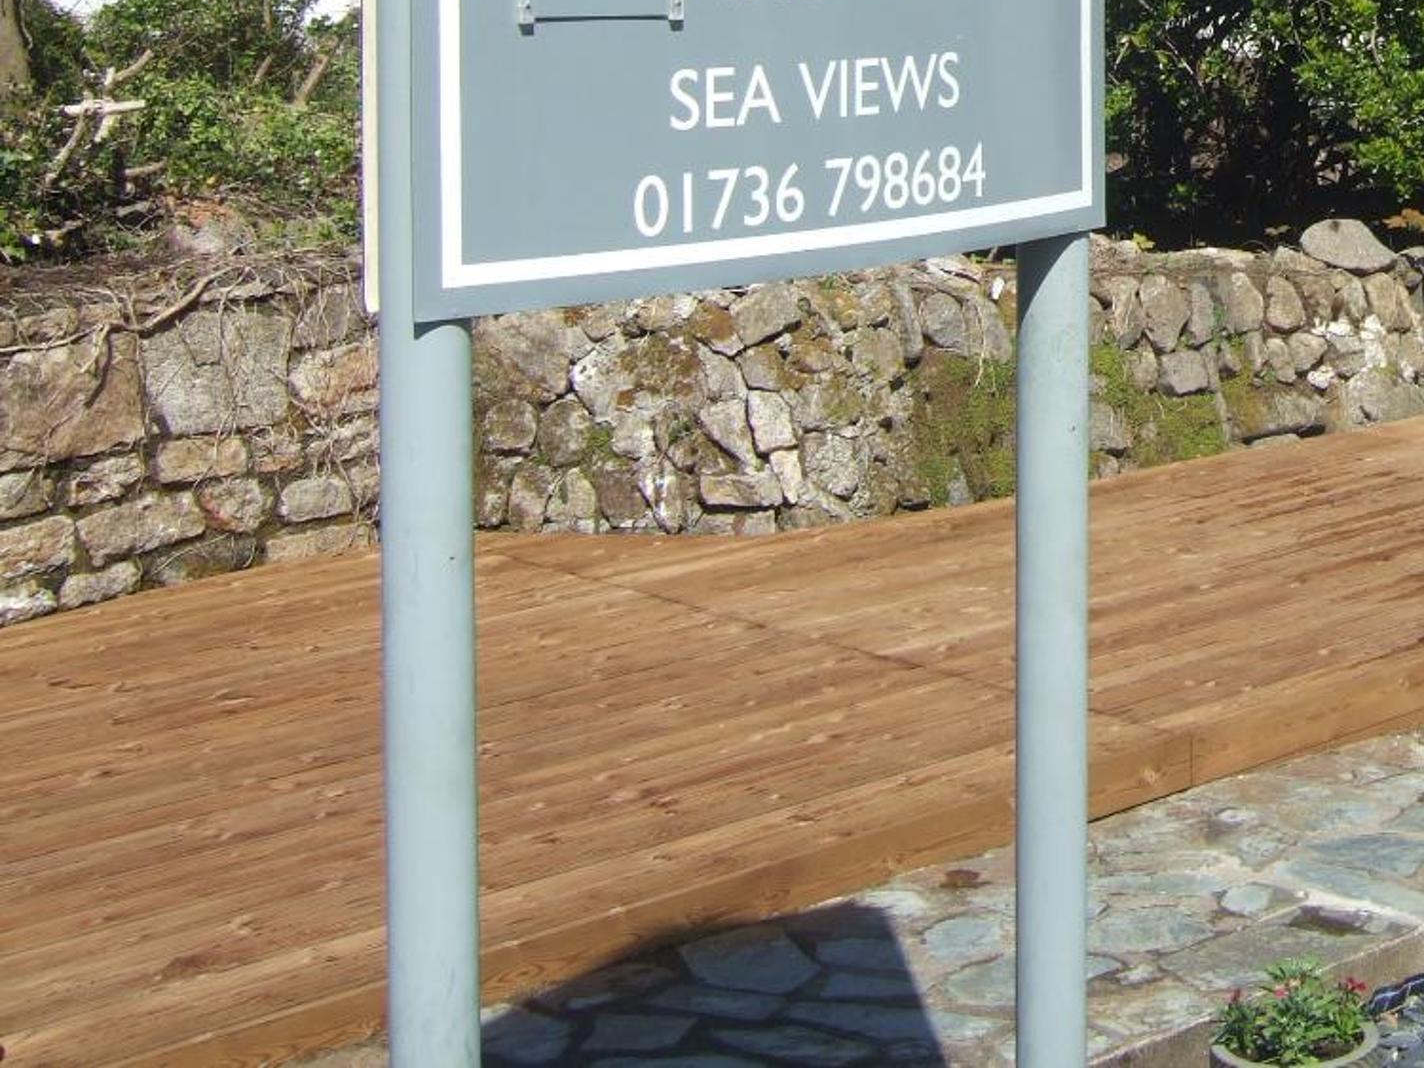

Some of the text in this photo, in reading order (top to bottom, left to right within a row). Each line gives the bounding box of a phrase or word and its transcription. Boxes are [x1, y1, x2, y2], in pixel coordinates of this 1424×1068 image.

[670, 51, 961, 131] SEA VIEWS
[633, 141, 987, 238] 01736 798684
